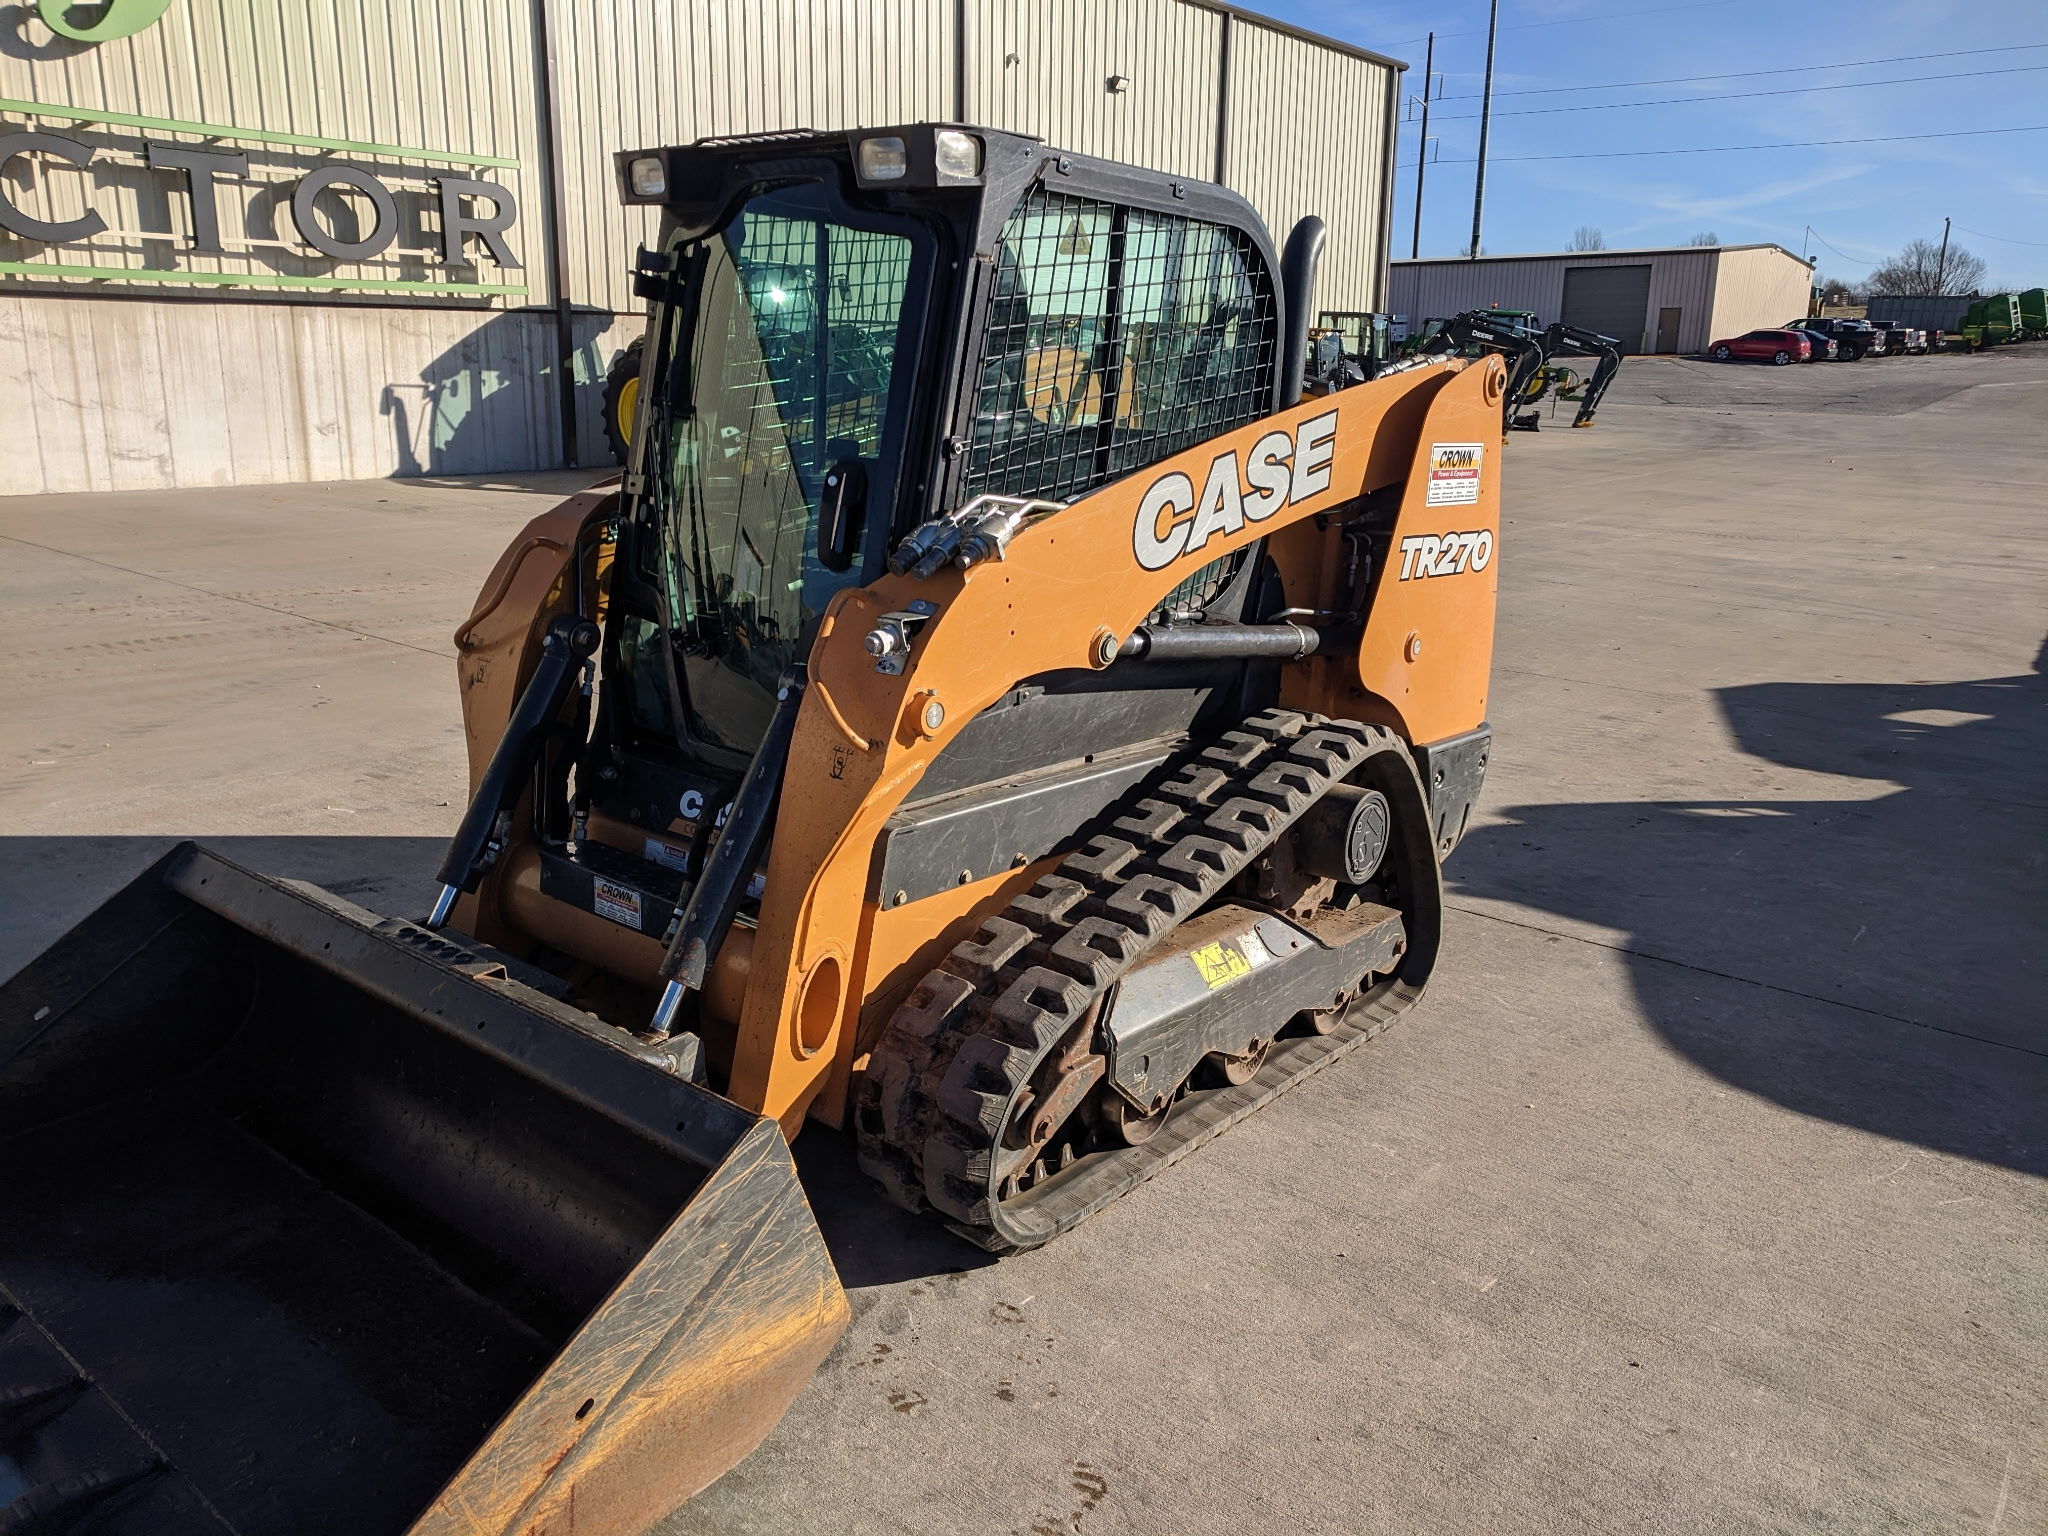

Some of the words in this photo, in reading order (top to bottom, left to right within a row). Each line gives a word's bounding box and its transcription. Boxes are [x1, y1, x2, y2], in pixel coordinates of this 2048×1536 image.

[1471, 329, 1495, 341] DEERE
[1563, 337, 1581, 347] DEERE
[1439, 450, 1475, 468] CROWN
[1132, 408, 1339, 572] CASE
[1399, 529, 1493, 582] TR270
[601, 883, 633, 904] CROWN
